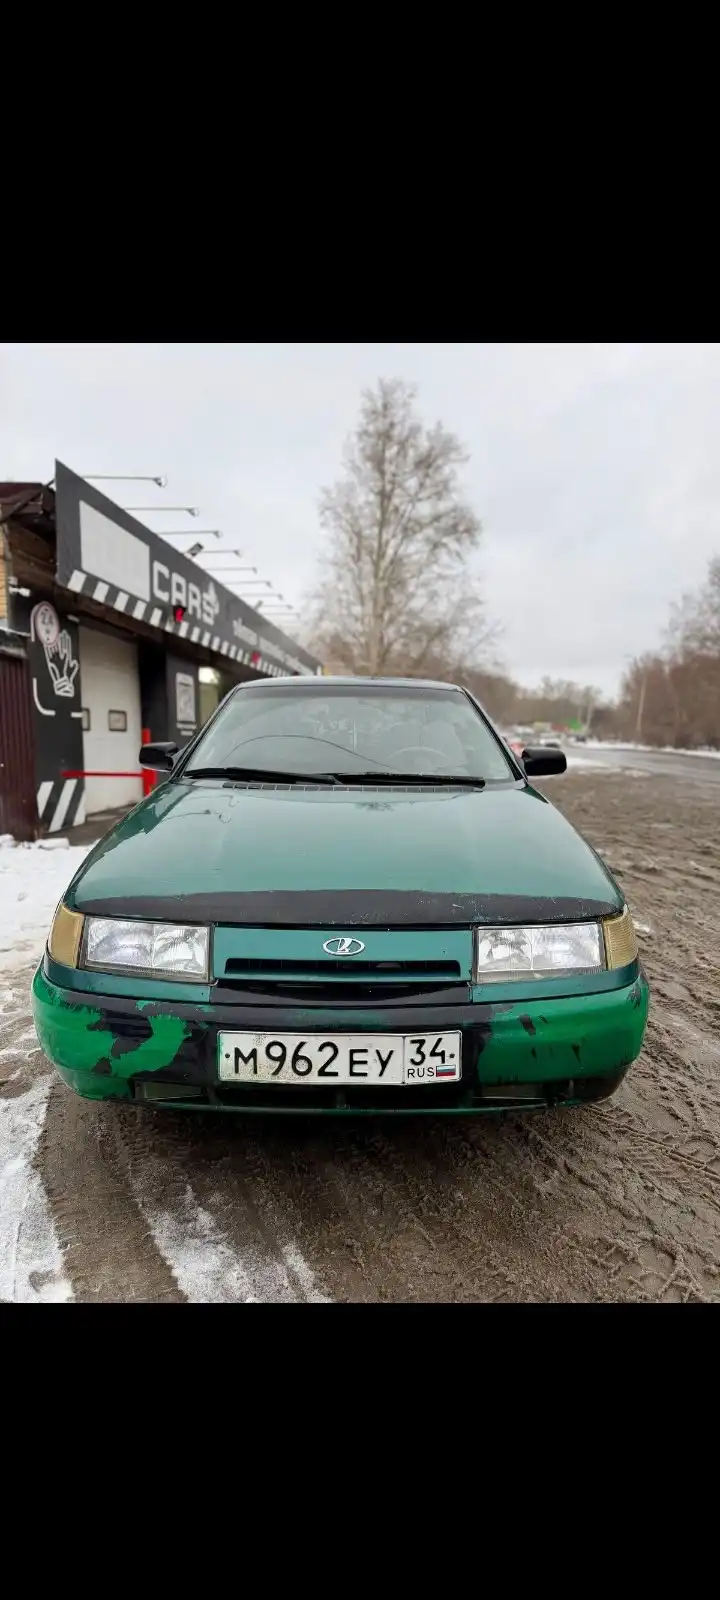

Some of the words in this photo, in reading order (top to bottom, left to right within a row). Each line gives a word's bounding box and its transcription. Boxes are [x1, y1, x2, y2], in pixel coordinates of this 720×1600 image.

[152, 560, 216, 626] CARS
[409, 1037, 446, 1066] 34
[407, 1066, 435, 1078] RUS
